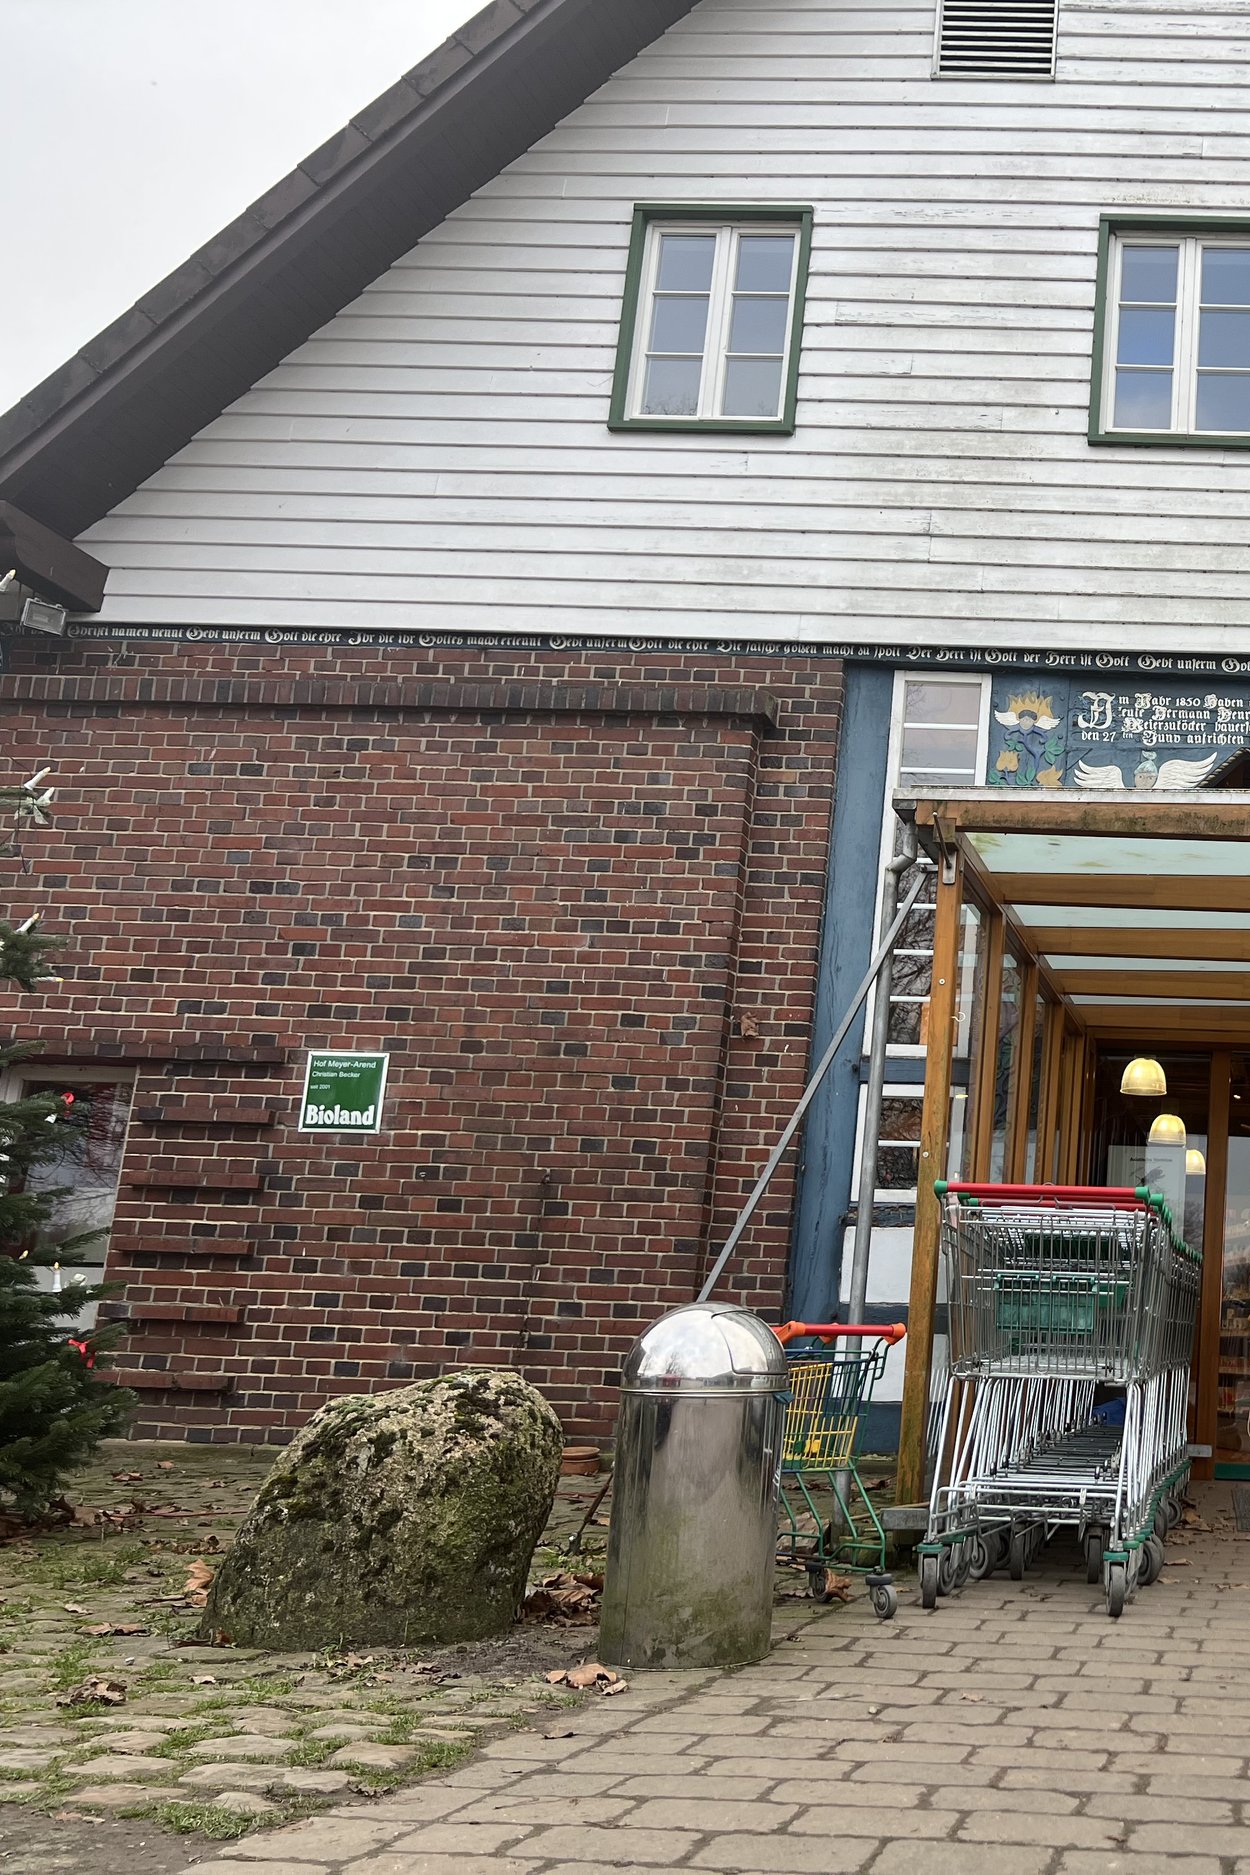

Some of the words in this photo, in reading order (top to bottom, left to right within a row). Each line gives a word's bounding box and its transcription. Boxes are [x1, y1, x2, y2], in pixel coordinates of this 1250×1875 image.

[265, 628, 298, 643] Gott
[628, 637, 662, 651] Gott
[906, 646, 931, 660] Der
[985, 648, 1017, 663] Gott
[1023, 651, 1040, 662] der
[1045, 651, 1075, 665] Herr
[1095, 652, 1129, 668] Gott
[1137, 653, 1173, 669] Gebt
[1177, 659, 1216, 671] unserm
[1176, 697, 1201, 706] 1850
[1082, 731, 1099, 741] den
[328, 1060, 376, 1069] Meyer-Arend
[305, 1104, 375, 1125] Bioland
